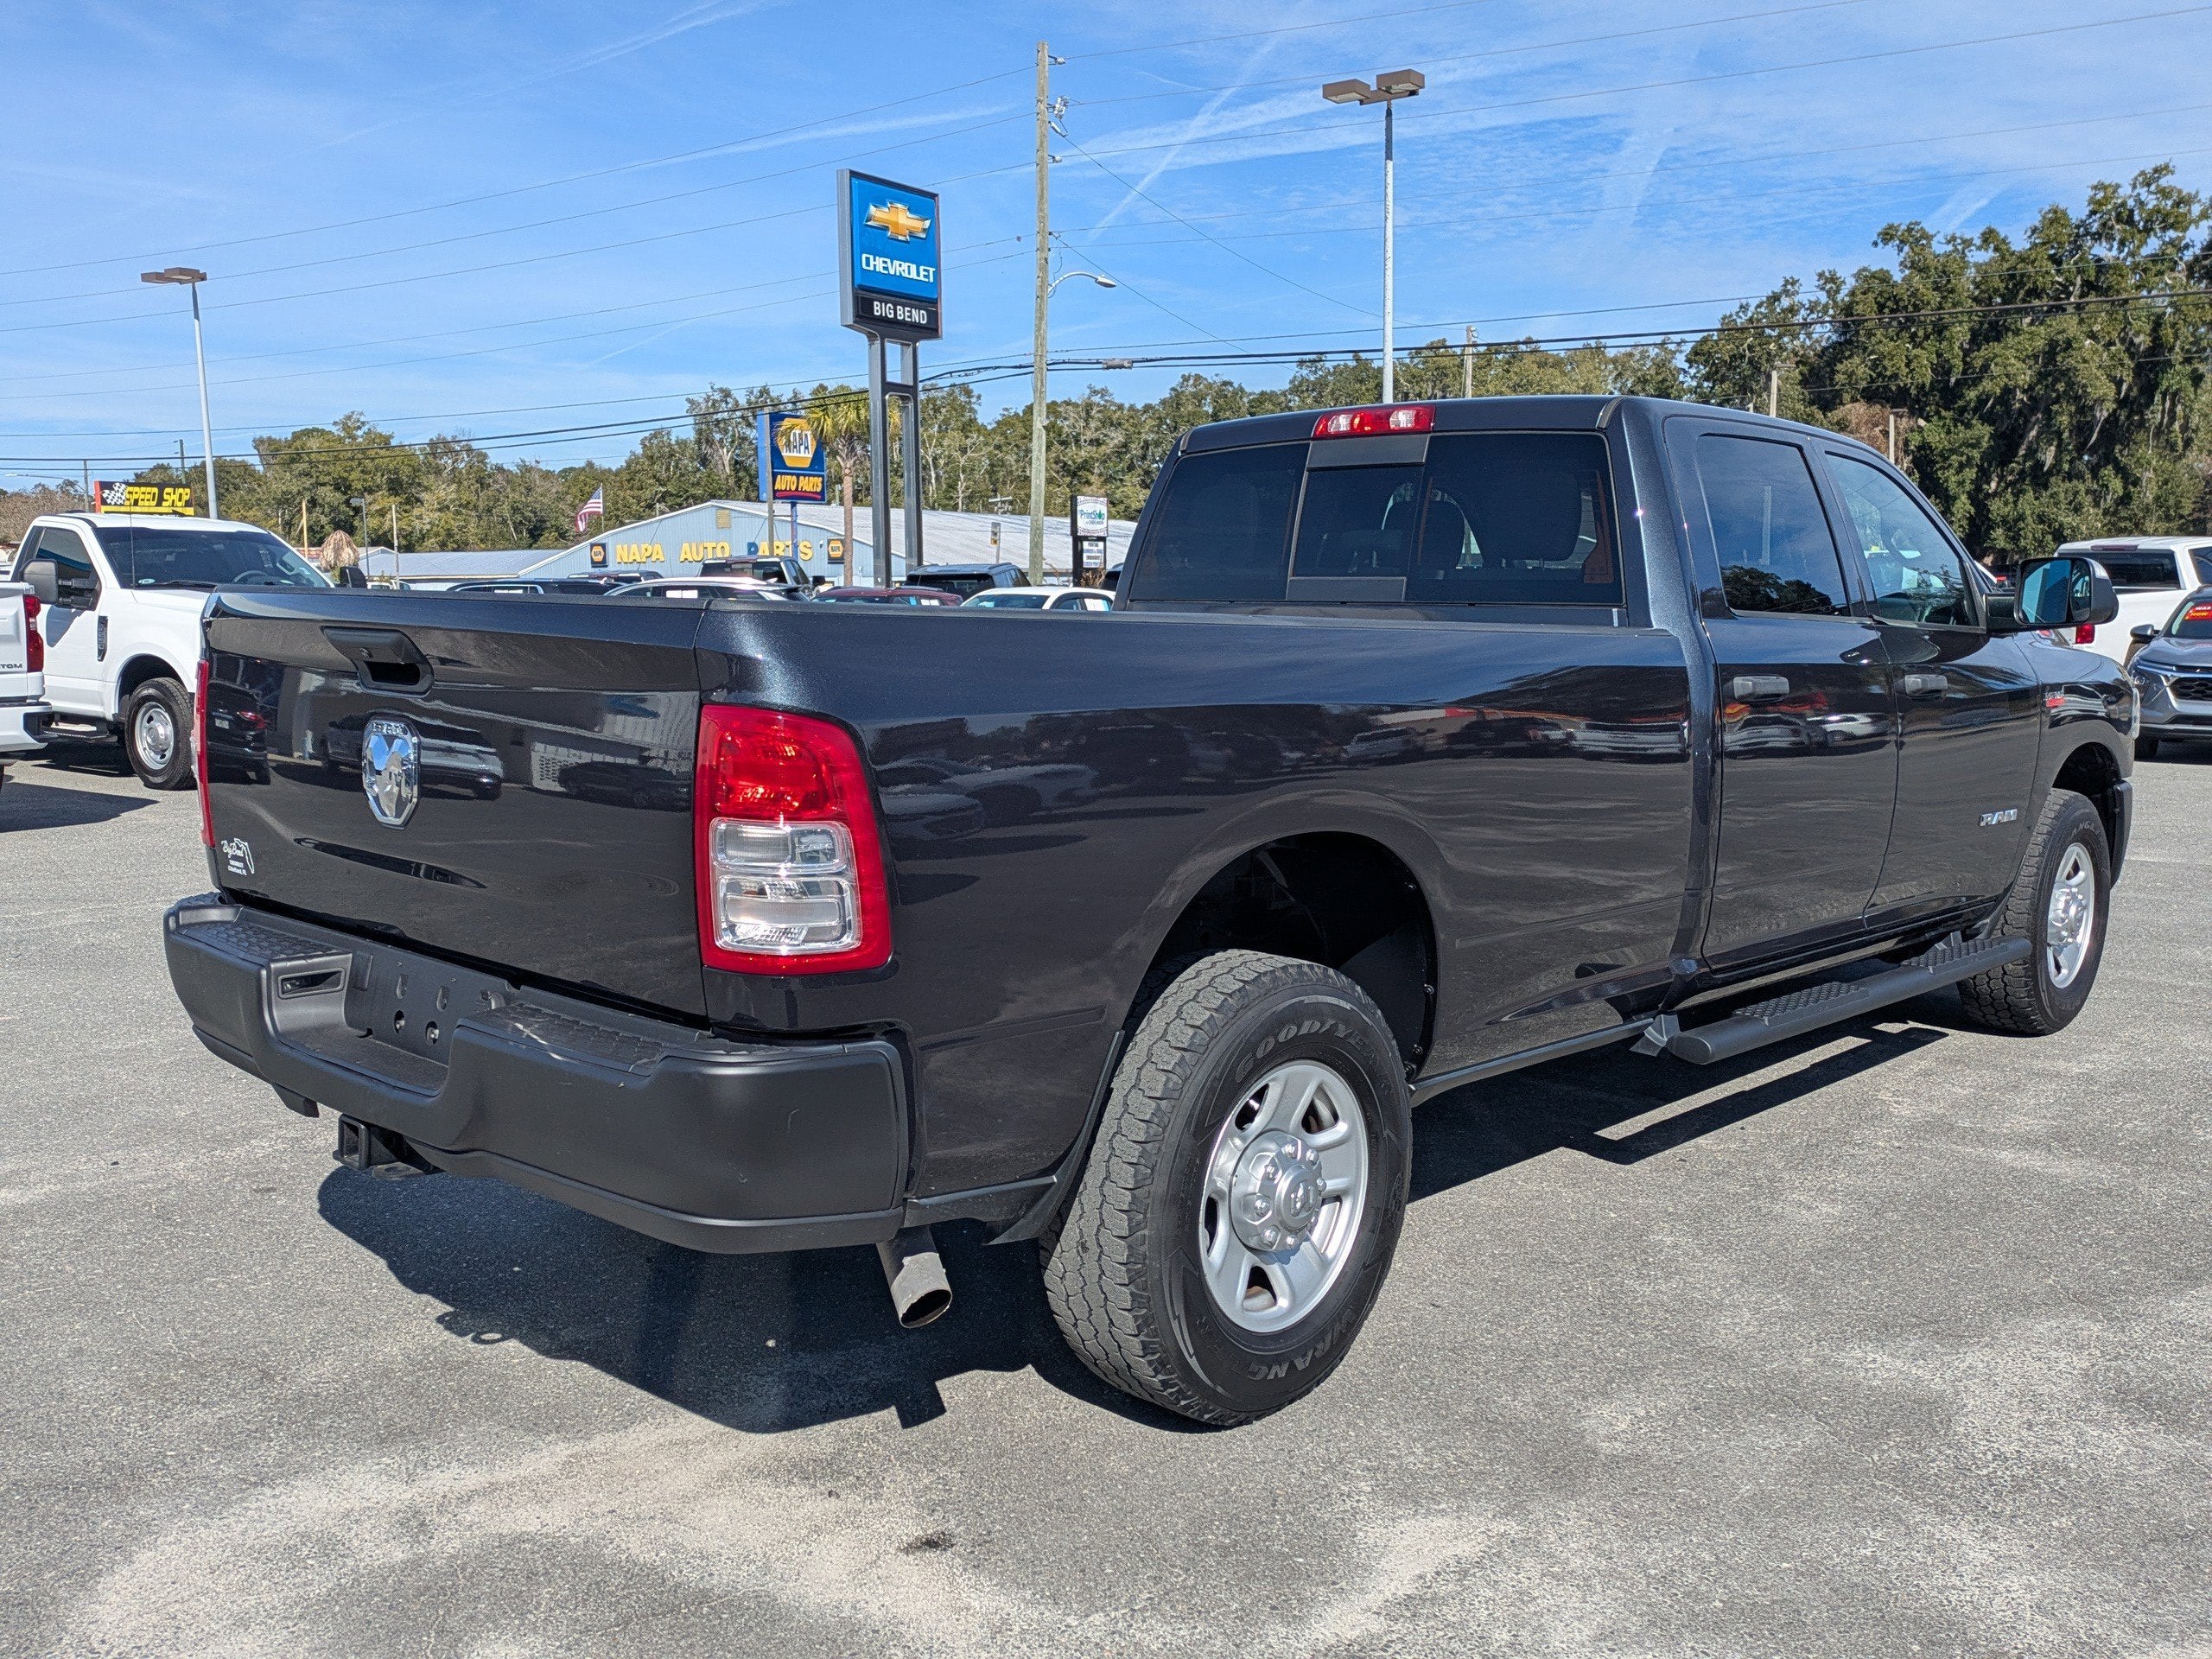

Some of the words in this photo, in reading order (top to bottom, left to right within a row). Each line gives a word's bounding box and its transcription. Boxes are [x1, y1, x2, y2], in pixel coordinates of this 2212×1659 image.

[861, 253, 937, 283] CHEVROLET
[873, 301, 894, 319] BIG
[897, 305, 928, 324] BEND
[785, 431, 810, 454] NAPA
[774, 474, 797, 491] AUTO
[798, 475, 823, 493] PARTS
[124, 486, 158, 506] SPEED
[162, 487, 191, 507] SHOP
[615, 543, 665, 563] NAPA
[679, 541, 731, 563] AUTO
[747, 540, 813, 561] PARTS
[1980, 809, 2018, 827] RAM
